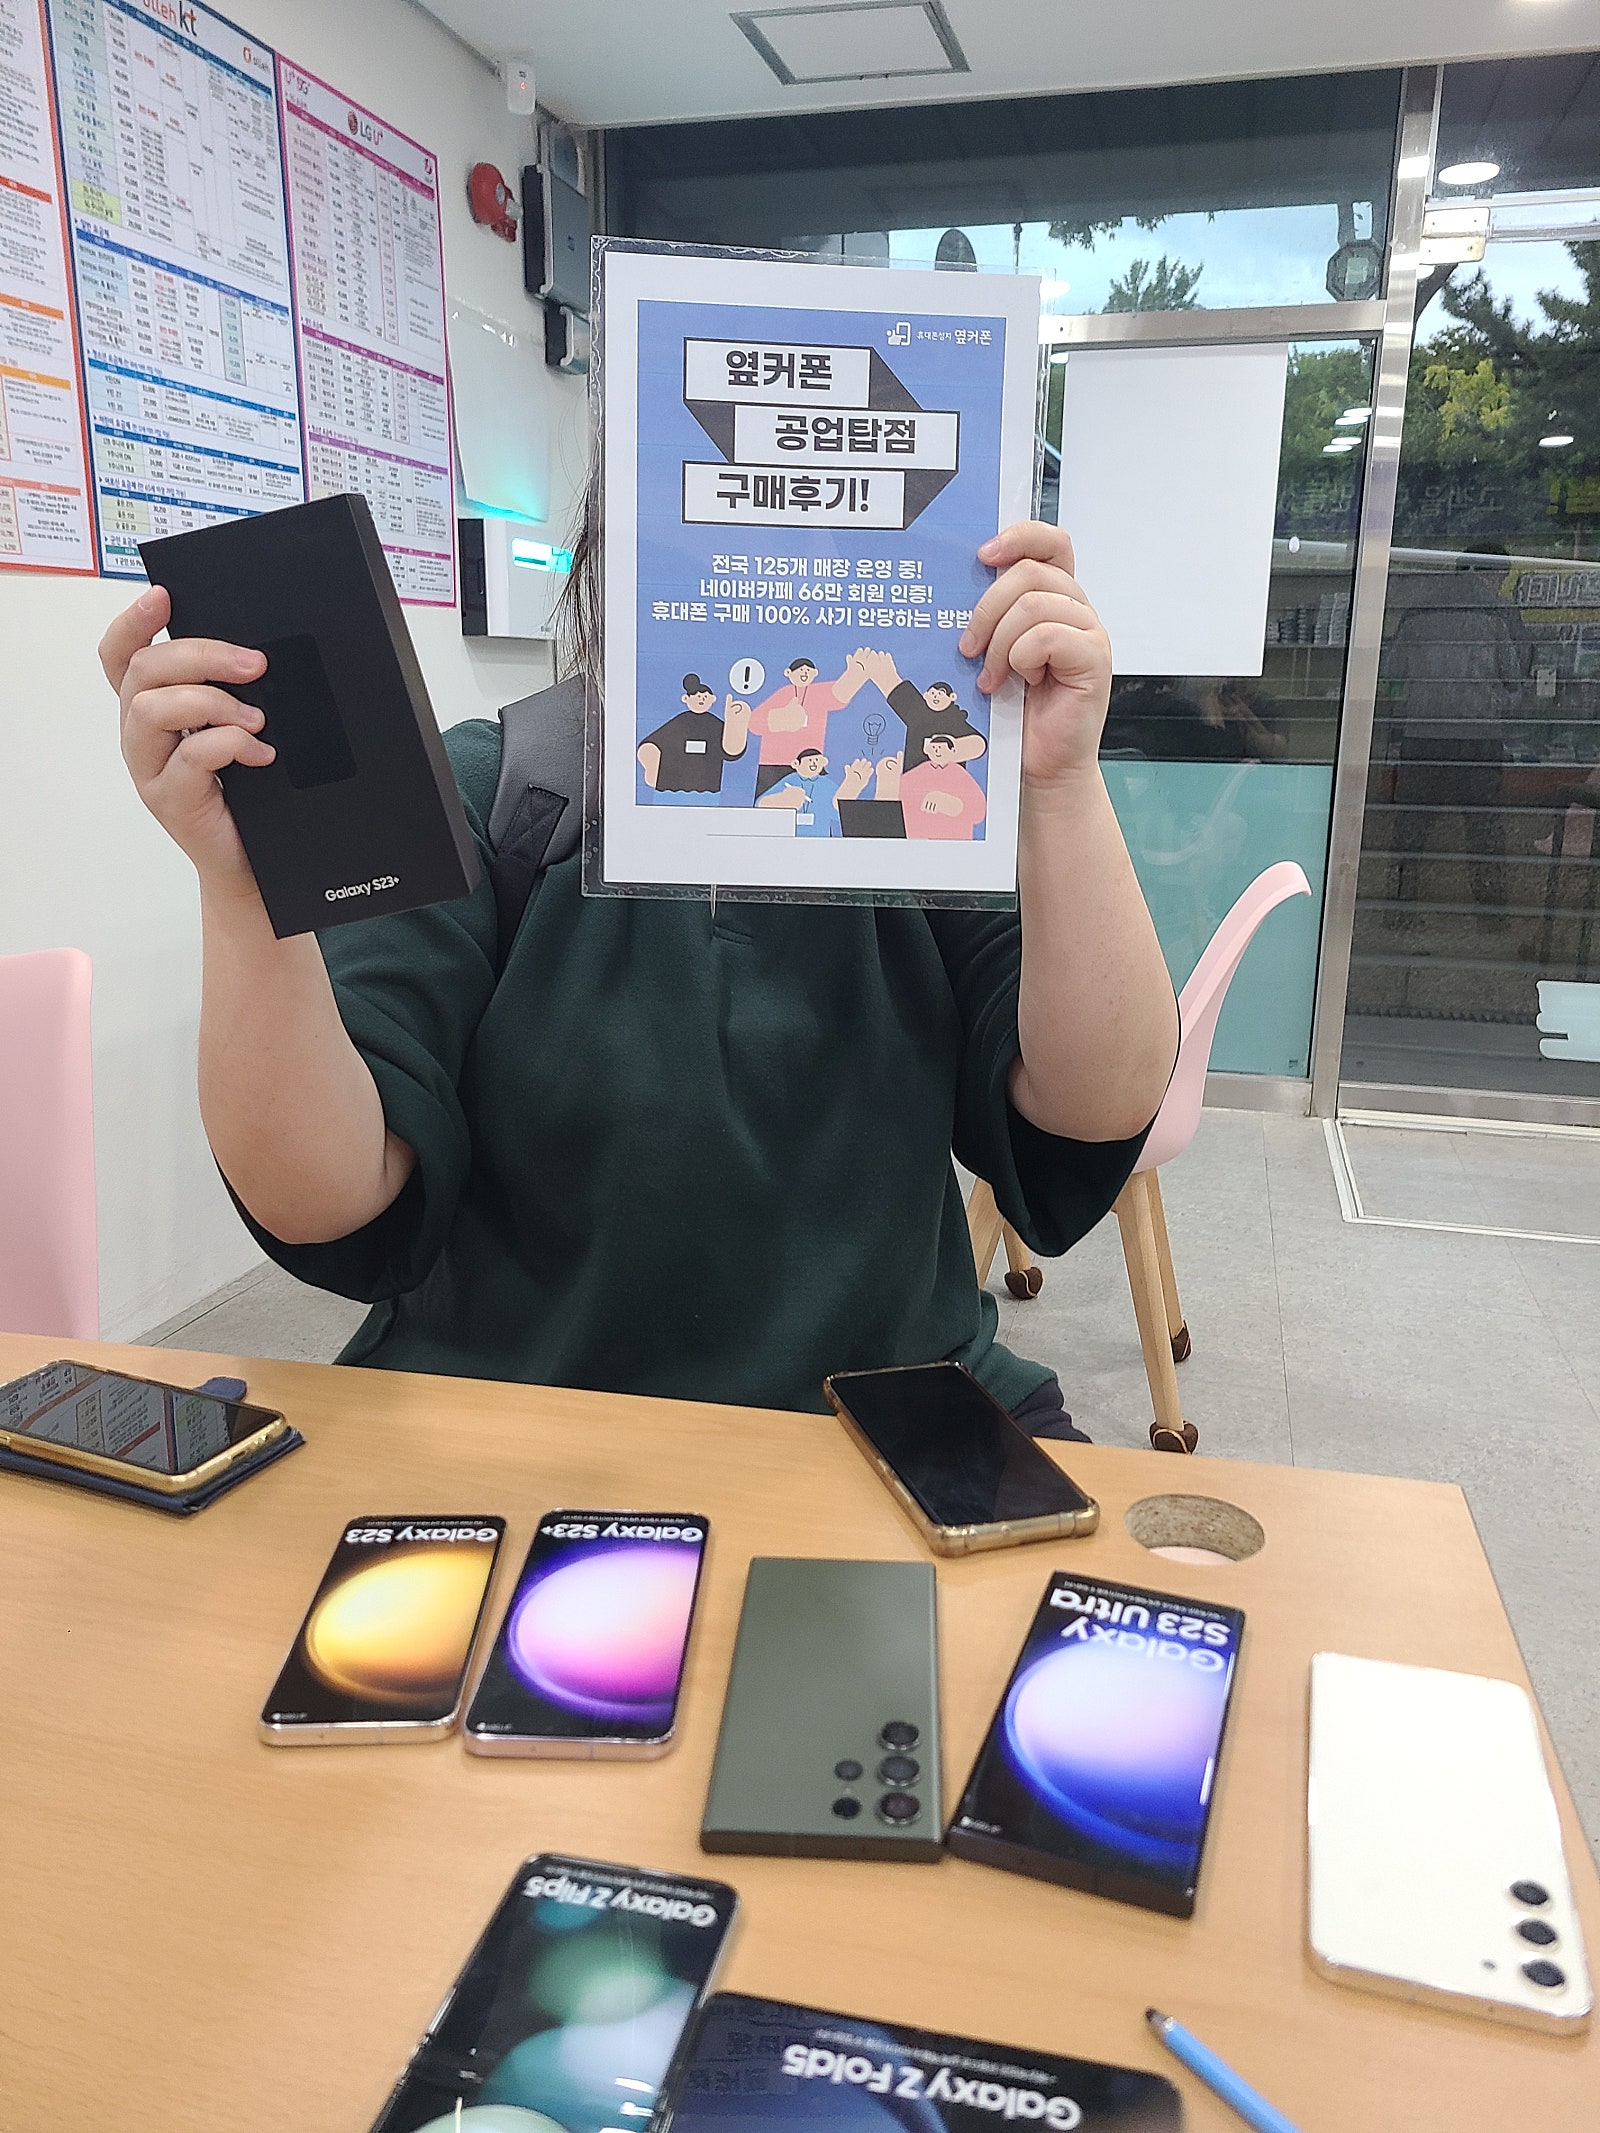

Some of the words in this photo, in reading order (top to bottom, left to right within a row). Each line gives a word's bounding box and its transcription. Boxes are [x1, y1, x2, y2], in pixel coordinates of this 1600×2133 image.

[179, 0, 198, 37] kt
[360, 120, 373, 141] LG
[954, 329, 993, 346] 옆커폰
[726, 349, 834, 391] 옆커폰
[774, 413, 917, 455] 공업탑점
[716, 472, 870, 513] 구매후기!
[712, 554, 749, 576] 전국
[754, 556, 808, 578] 125개
[813, 557, 850, 579] 매장
[855, 558, 892, 579] 운영
[898, 559, 923, 580] 중!
[699, 579, 793, 602] 네이버카페
[798, 581, 843, 603] 66만
[847, 583, 885, 604] 회원
[890, 584, 934, 604] 인증!
[651, 600, 708, 623] 휴대폰
[713, 601, 750, 624] 구매
[755, 603, 810, 626] 100%
[815, 604, 853, 627] 사기
[857, 605, 931, 629] 안당하는
[937, 609, 973, 629] 방법
[324, 882, 371, 902] Galaxy
[372, 875, 400, 891] S23+
[345, 1526, 393, 1543] S23
[396, 1526, 499, 1543] Galaxy
[541, 1523, 595, 1541] S23+
[600, 1521, 705, 1544] Galaxy
[1049, 1587, 1151, 1630] Ultra
[1060, 1615, 1226, 1673] Galaxy
[1156, 1611, 1232, 1647] S23
[523, 1874, 589, 1908] Flip5
[587, 1887, 613, 1910] Z
[611, 1886, 719, 1928] Galaxy
[781, 2043, 893, 2095] Fold5
[893, 2064, 929, 2100] Z
[925, 2075, 1083, 2132] Galaxy
